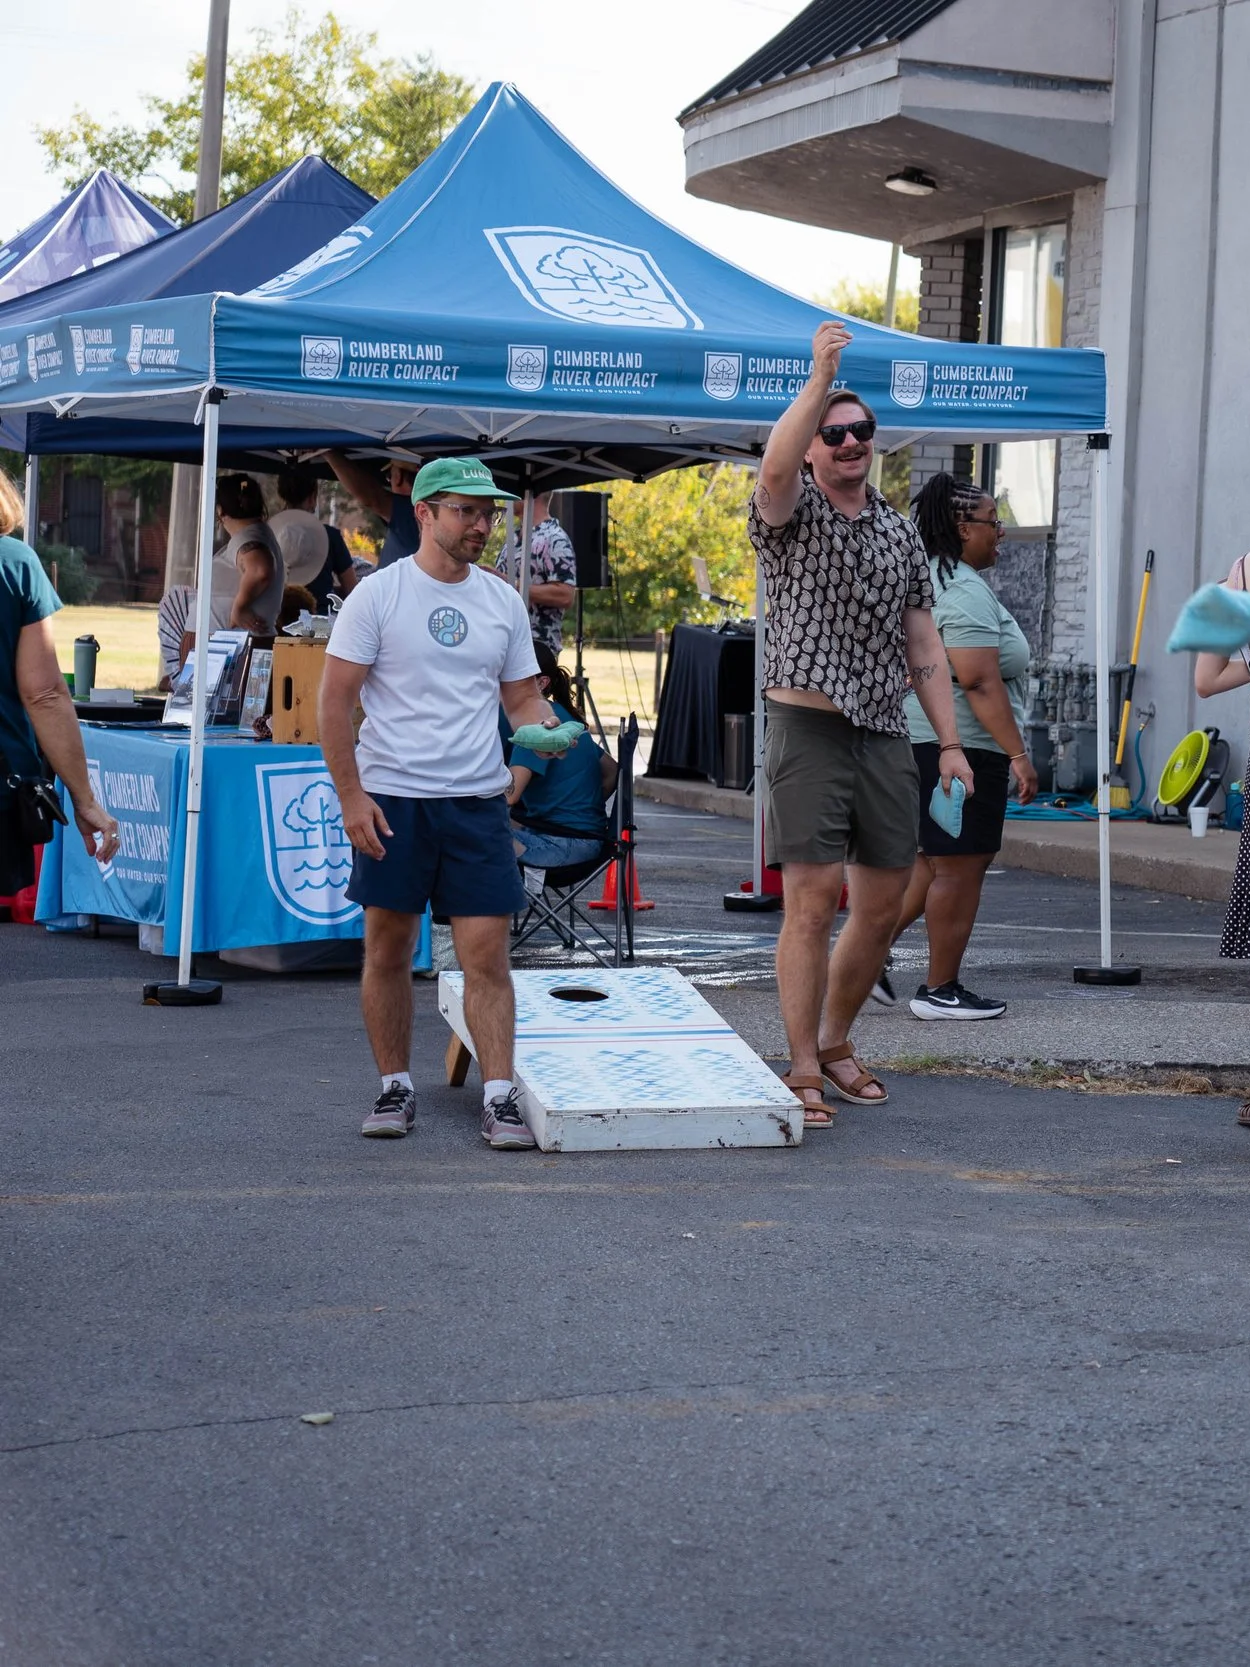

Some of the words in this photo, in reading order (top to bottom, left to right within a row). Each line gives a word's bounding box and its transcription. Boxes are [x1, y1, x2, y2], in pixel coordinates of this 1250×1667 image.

[143, 329, 175, 344] CUMBERLAND
[349, 341, 443, 361] CUMBERLAND
[553, 350, 643, 369] CUMBERLAND
[348, 361, 389, 379] RIVER
[393, 363, 460, 381] COMPACT
[748, 357, 815, 375] CUMBERLA
[933, 365, 1014, 382] CUMBERLAND
[552, 370, 591, 386] RIVER
[595, 371, 658, 388] COMPACT
[746, 377, 783, 393] RIVER
[931, 384, 967, 399] RIVER
[971, 385, 1029, 401] COMPACT
[104, 771, 160, 812] CUMBERLAND
